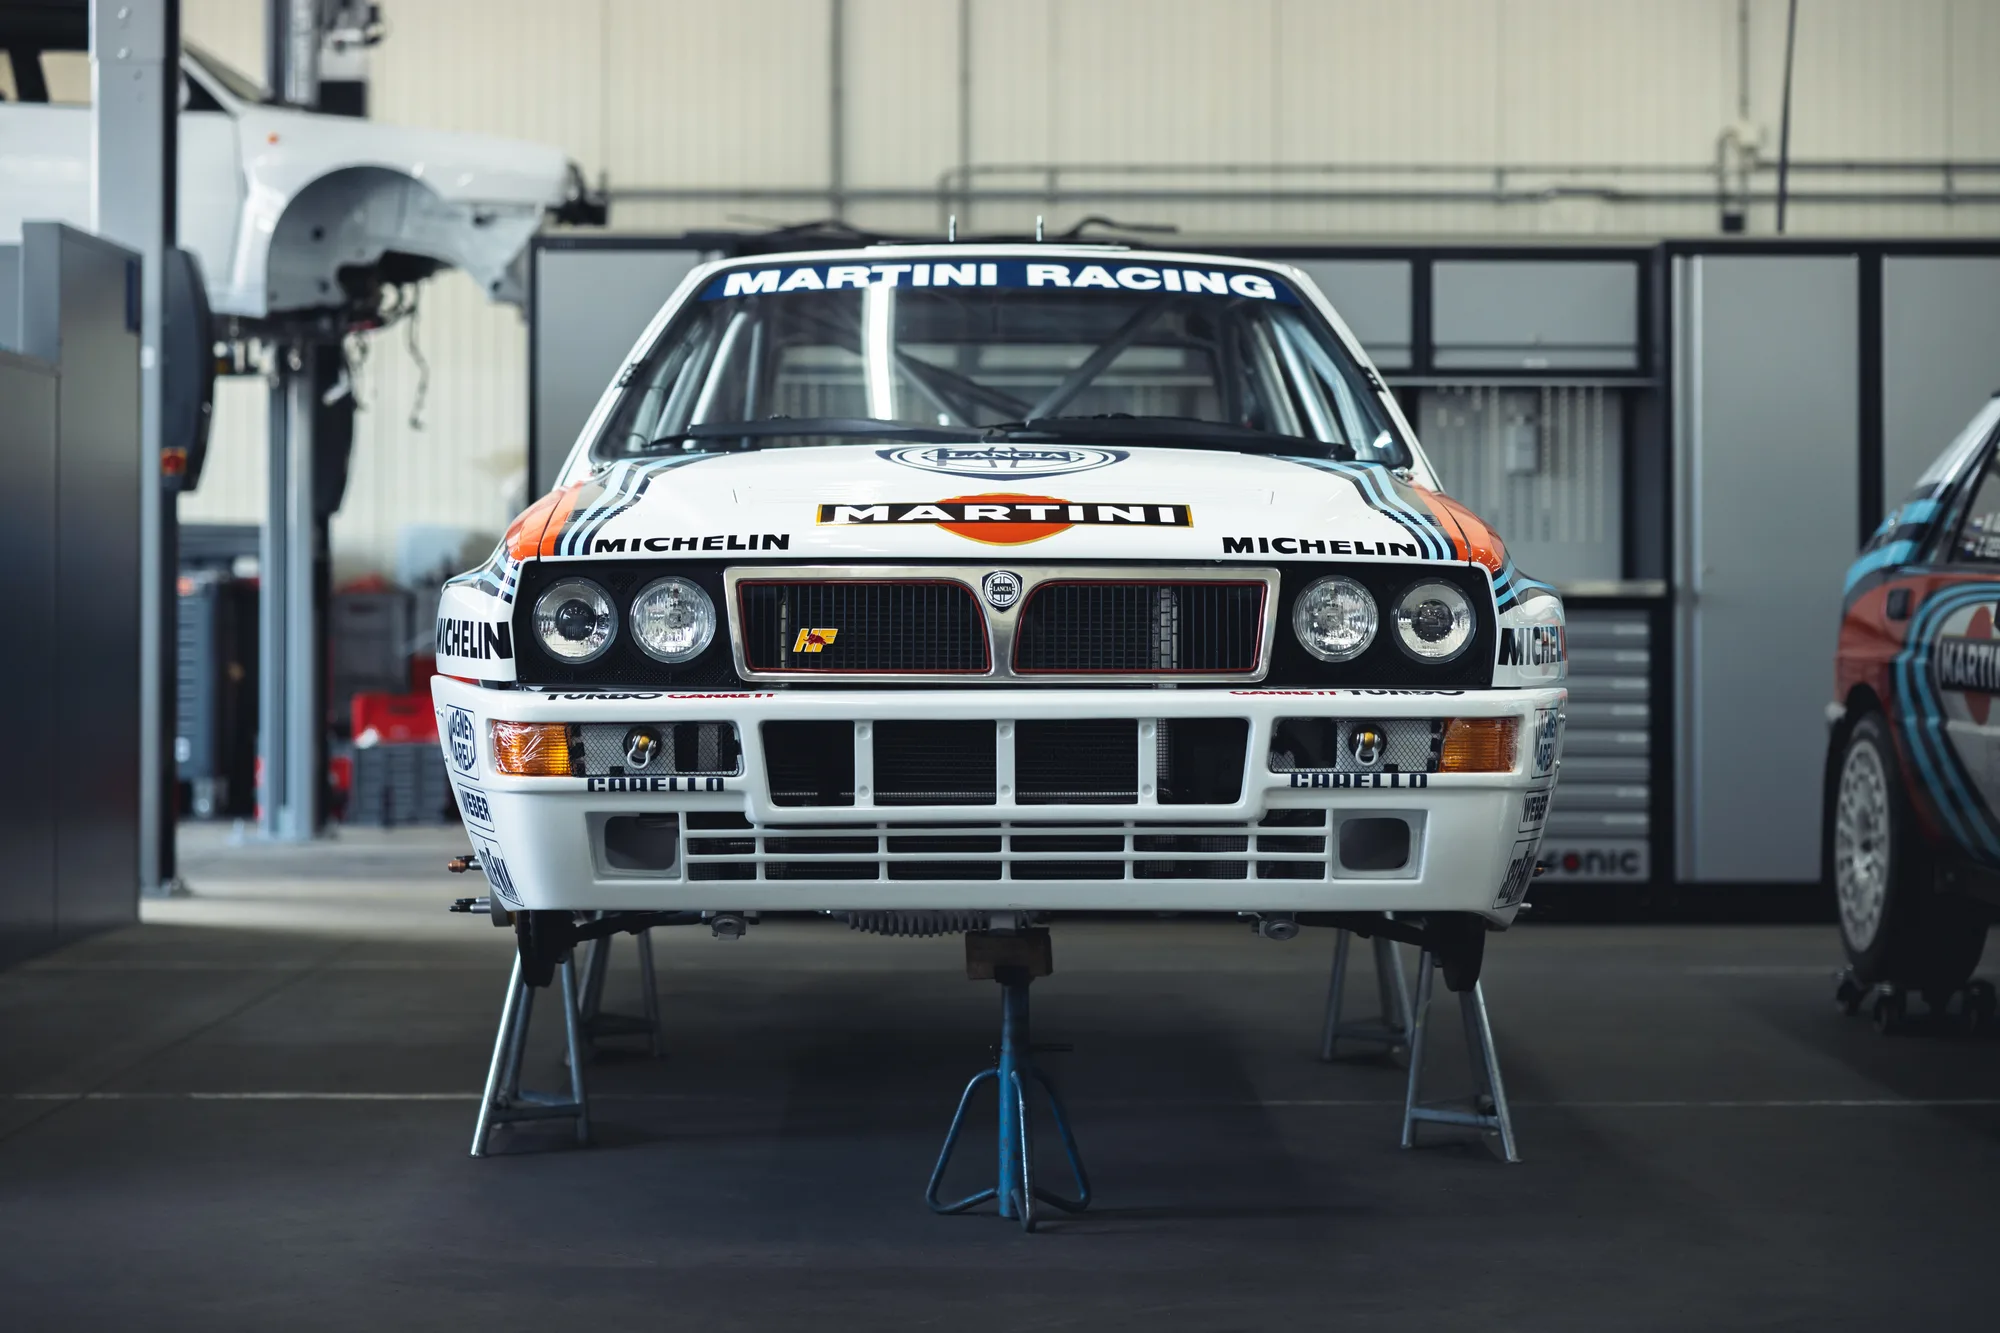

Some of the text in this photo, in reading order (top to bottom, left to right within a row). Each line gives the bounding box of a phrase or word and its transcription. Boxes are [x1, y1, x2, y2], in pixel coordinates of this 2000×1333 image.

[723, 263, 1277, 300] MARTINI RACING
[947, 452, 1065, 460] LANCIA
[834, 505, 1175, 523] MARTINI
[594, 533, 790, 553] MICHELIN
[1222, 536, 1417, 557] MICHELIN
[436, 617, 514, 660] MICHELIN
[792, 627, 839, 653] HF
[1497, 625, 1567, 666] MICHEL
[545, 692, 663, 700] TURBO
[1342, 689, 1466, 697] TURBO
[587, 777, 725, 792] CARELLO
[1291, 773, 1428, 788] CARELLO
[460, 789, 492, 822] WEBER
